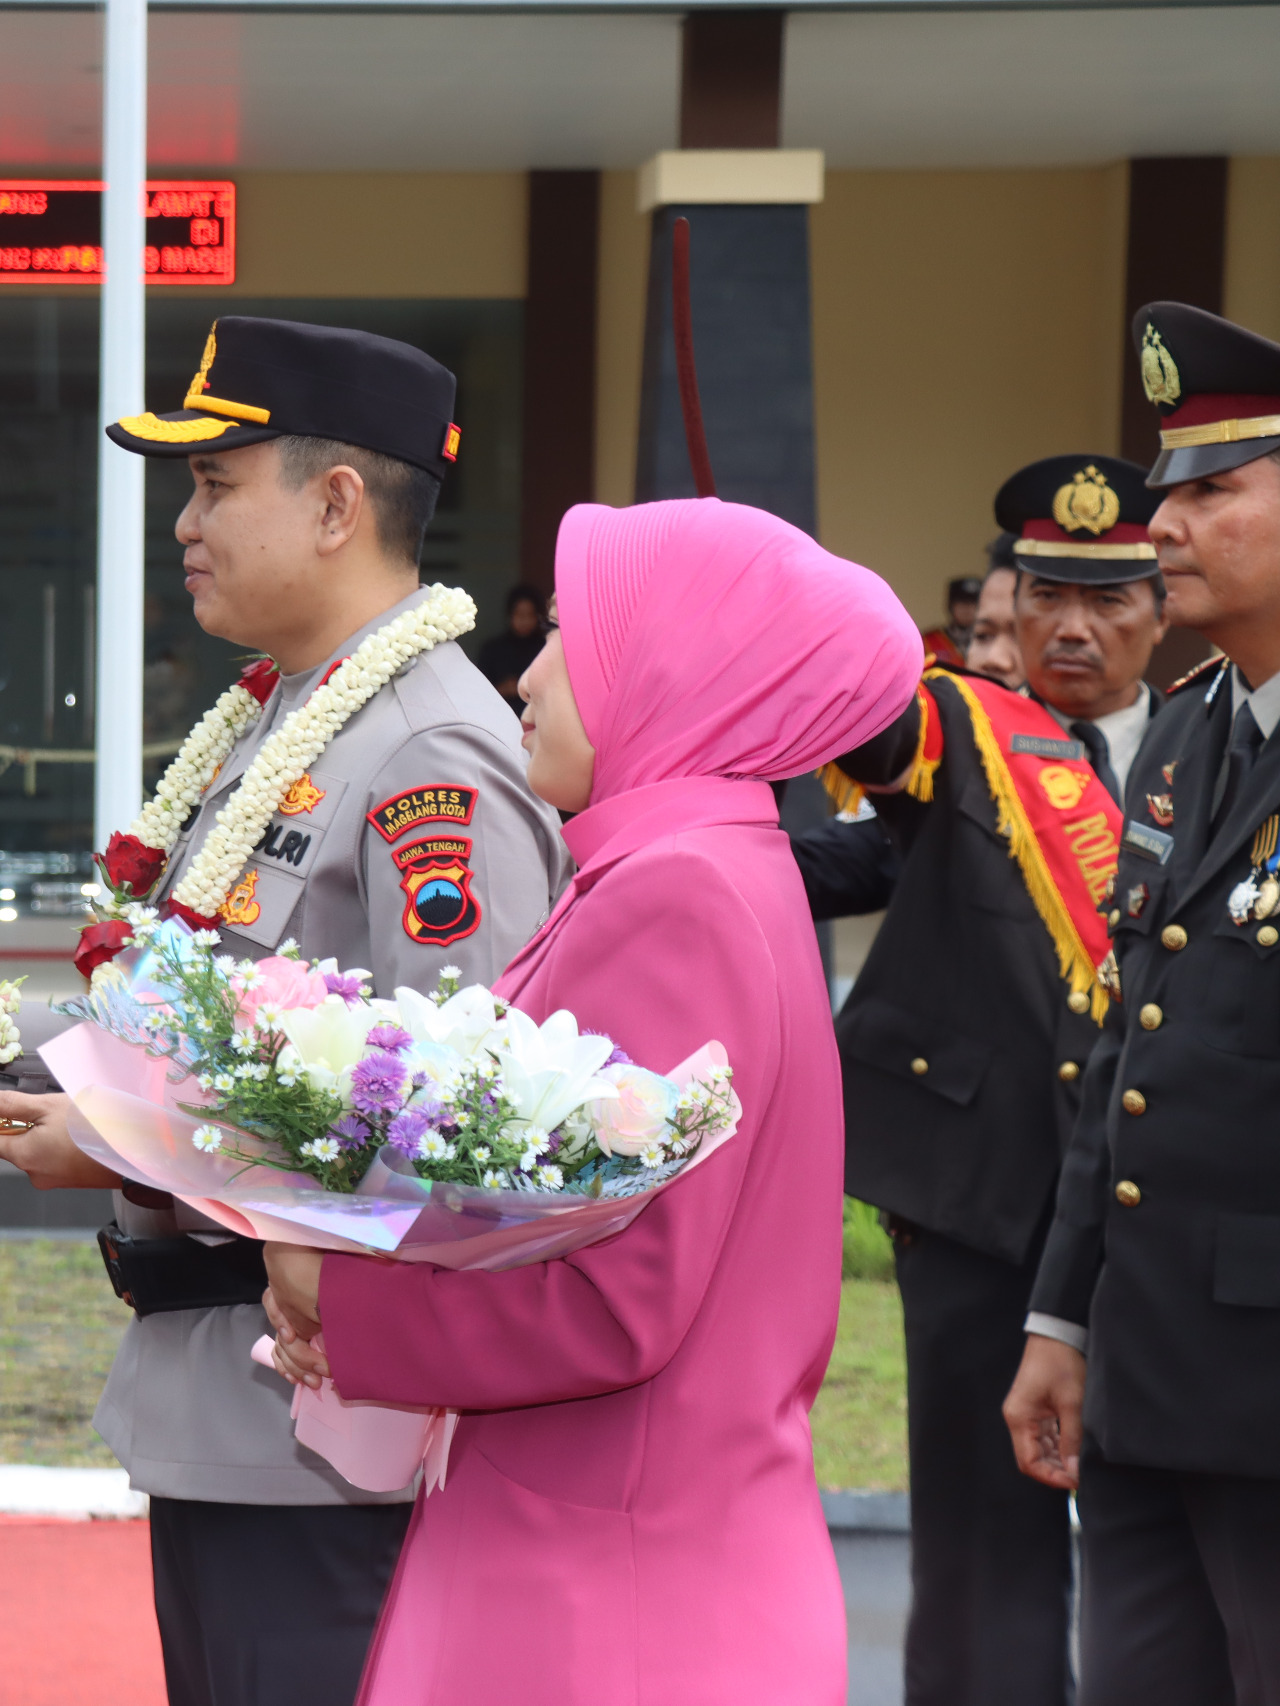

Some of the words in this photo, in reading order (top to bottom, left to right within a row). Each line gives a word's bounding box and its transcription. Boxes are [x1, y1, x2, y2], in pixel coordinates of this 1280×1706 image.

[384, 790, 461, 820] POLRES
[384, 803, 438, 836] MAGELANG
[440, 803, 466, 819] KOTA
[252, 821, 312, 867] OLRI
[400, 845, 425, 863] JAWA
[426, 841, 466, 853] TENGAH
